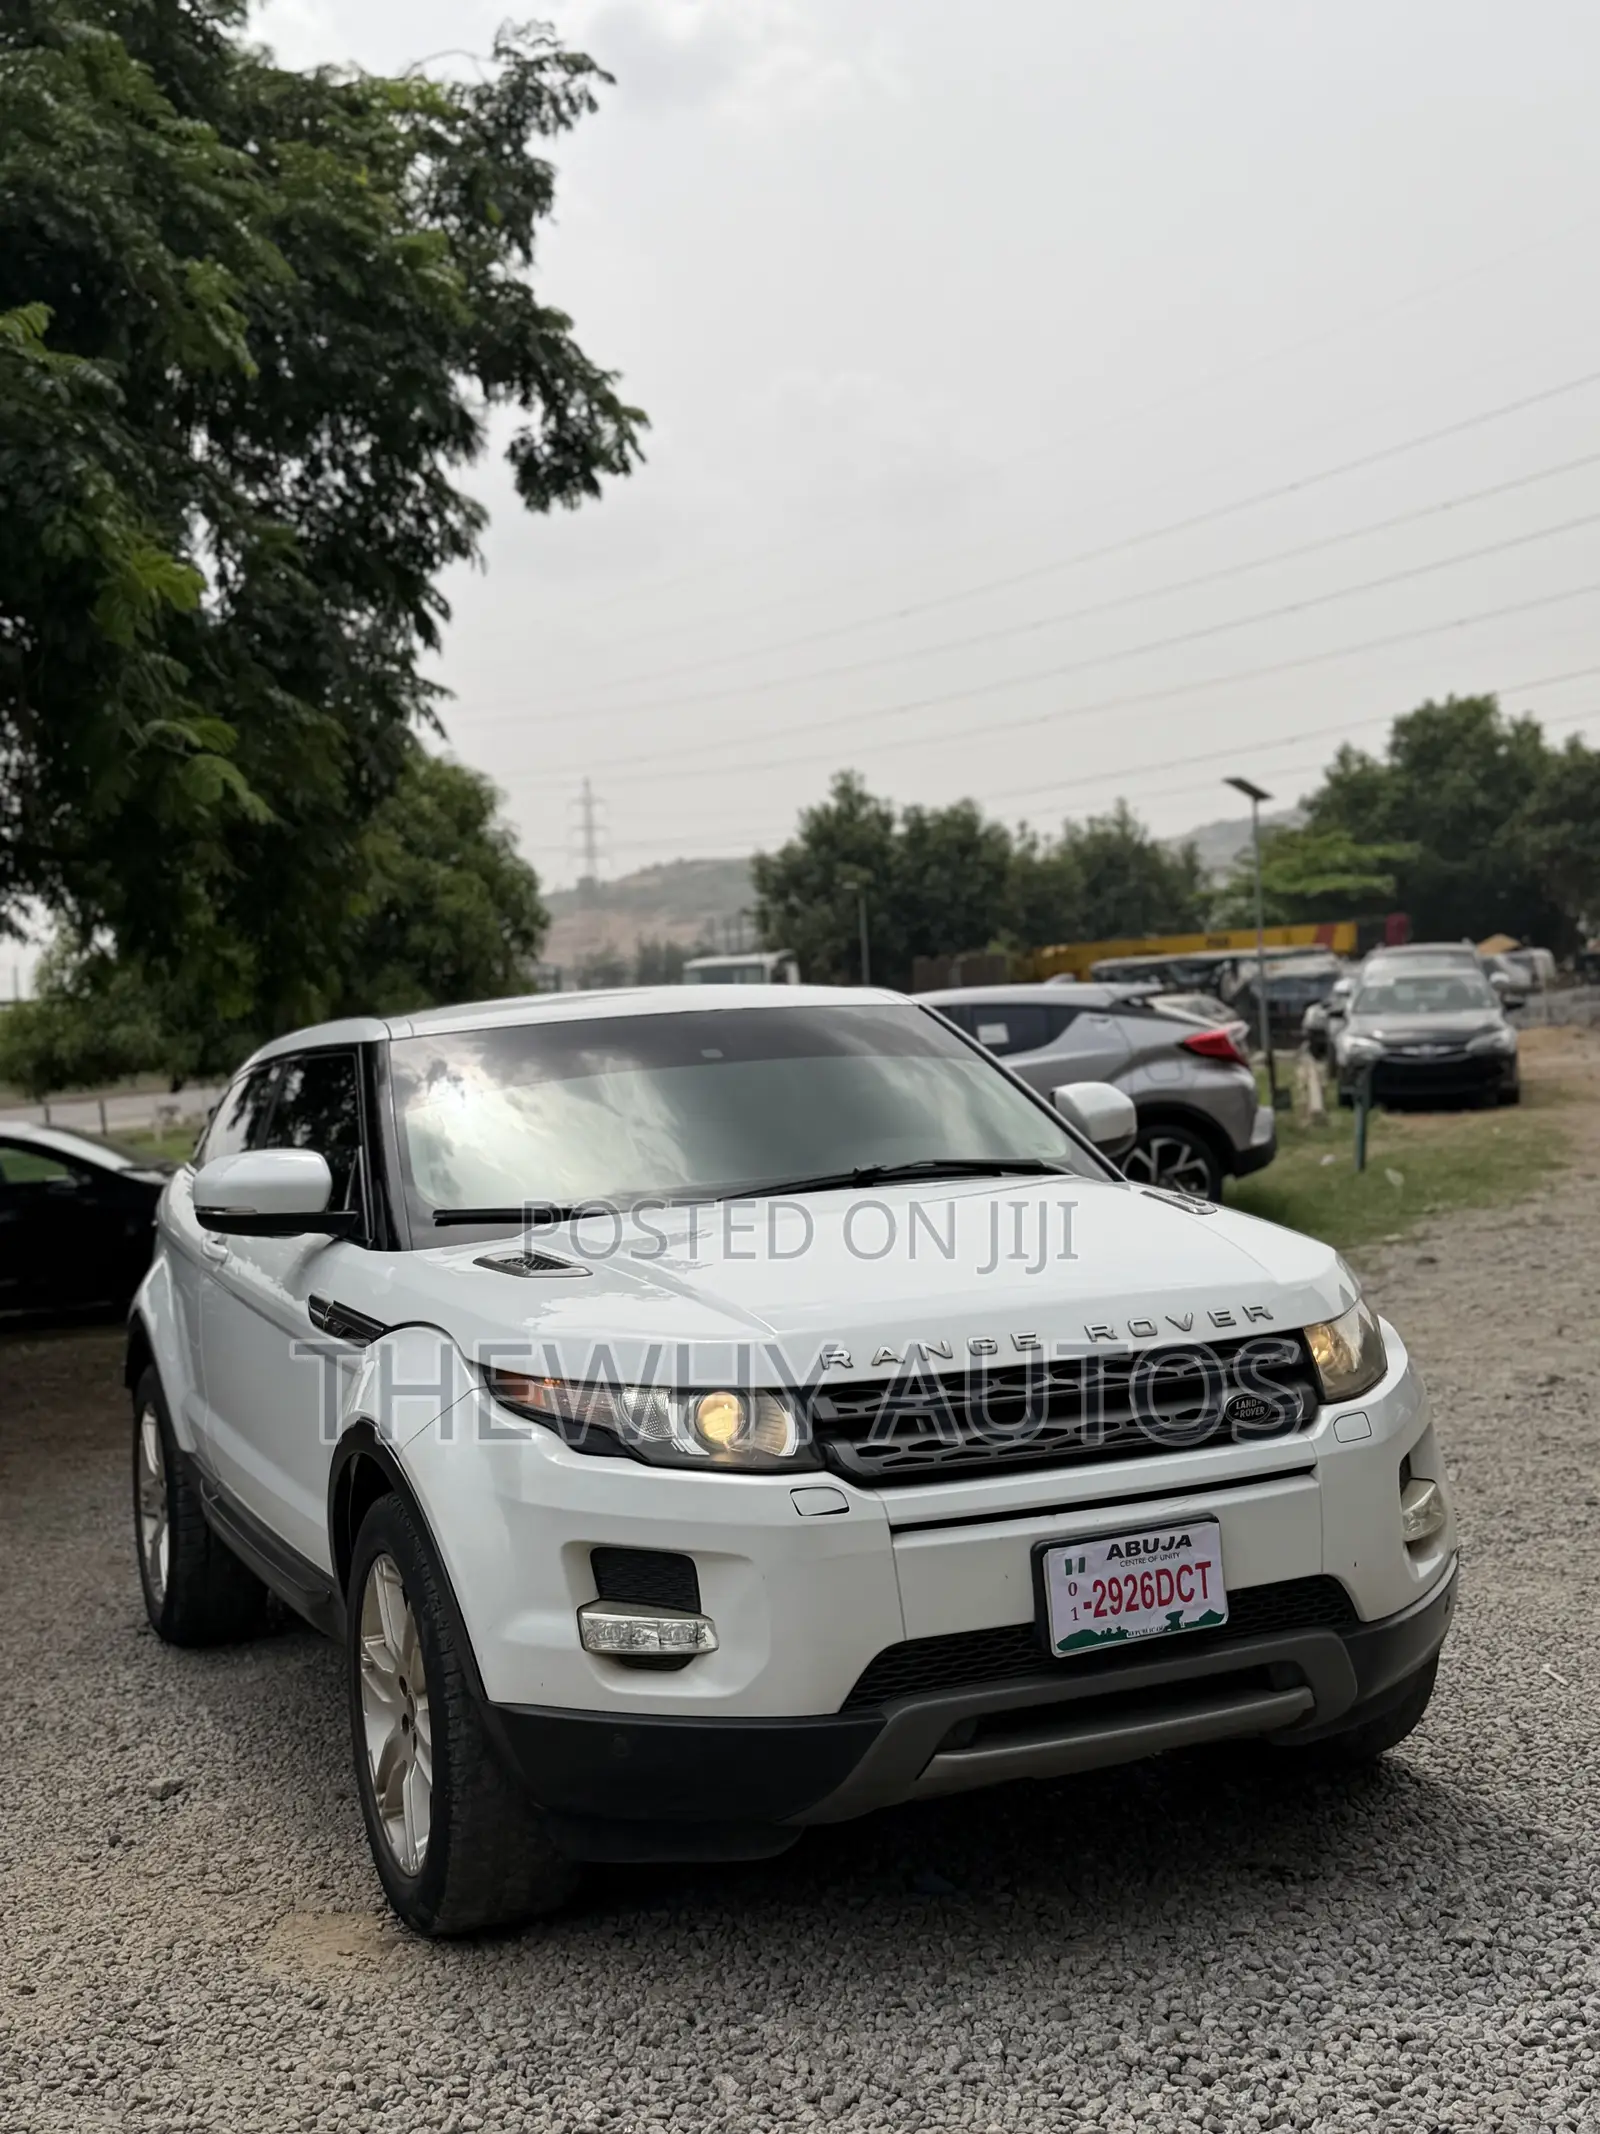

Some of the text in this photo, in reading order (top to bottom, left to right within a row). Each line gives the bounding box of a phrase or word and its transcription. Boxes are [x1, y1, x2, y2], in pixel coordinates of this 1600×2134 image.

[820, 1304, 1275, 1371] RANGE ROVER
[1236, 1399, 1257, 1410] LAND
[1240, 1406, 1265, 1418] ROVER
[1106, 1534, 1192, 1561] ABUJA
[1120, 1551, 1181, 1567] CENTRE OF UNITY
